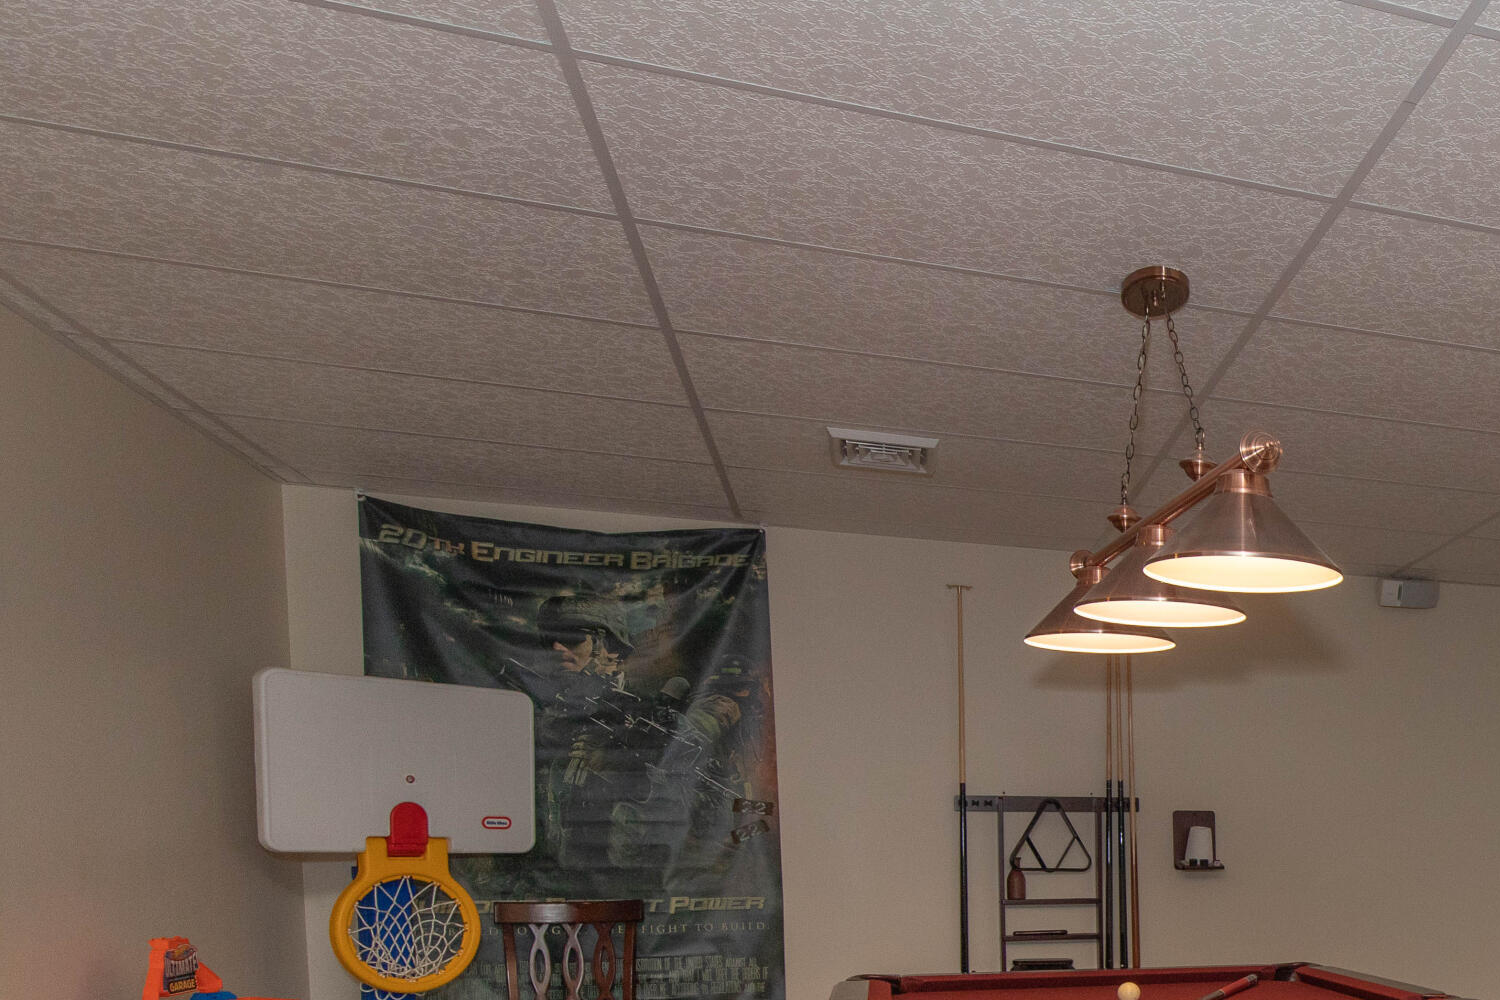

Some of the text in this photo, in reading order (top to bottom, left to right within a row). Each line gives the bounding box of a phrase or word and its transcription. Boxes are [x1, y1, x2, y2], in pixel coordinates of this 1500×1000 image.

[471, 540, 623, 567] ENGINEER
[668, 896, 766, 915] POWER
[169, 979, 196, 992] GARAGE
